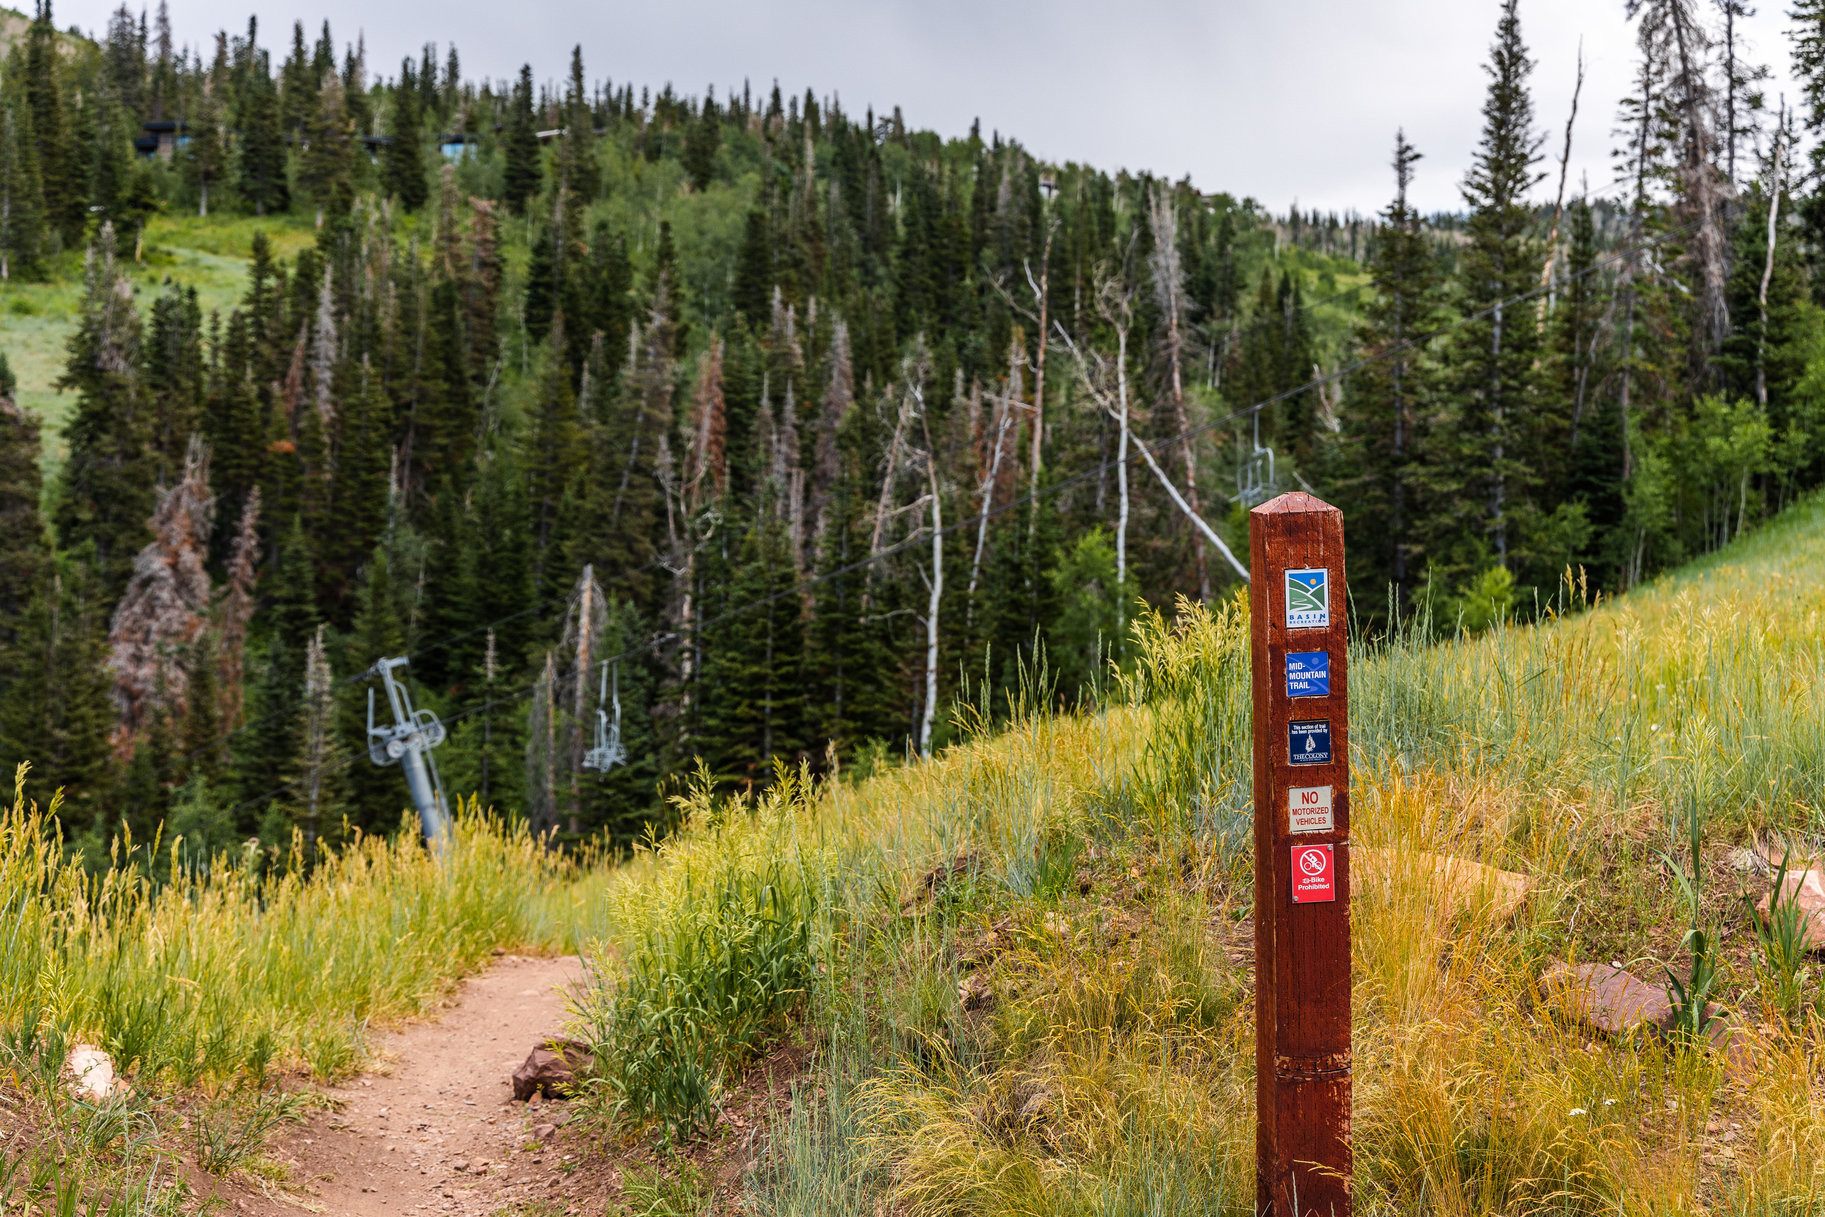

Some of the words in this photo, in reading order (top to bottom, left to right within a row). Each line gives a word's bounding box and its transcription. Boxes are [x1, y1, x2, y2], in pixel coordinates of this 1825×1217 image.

[1289, 662, 1306, 670] MID-
[1289, 671, 1326, 680] MOUNTAIN
[1290, 681, 1310, 690] TRAIL
[1301, 791, 1319, 805] NO
[1292, 806, 1329, 815] MOTORIZED
[1296, 817, 1327, 825] VEHICLES
[1298, 883, 1330, 891] Prohibited
